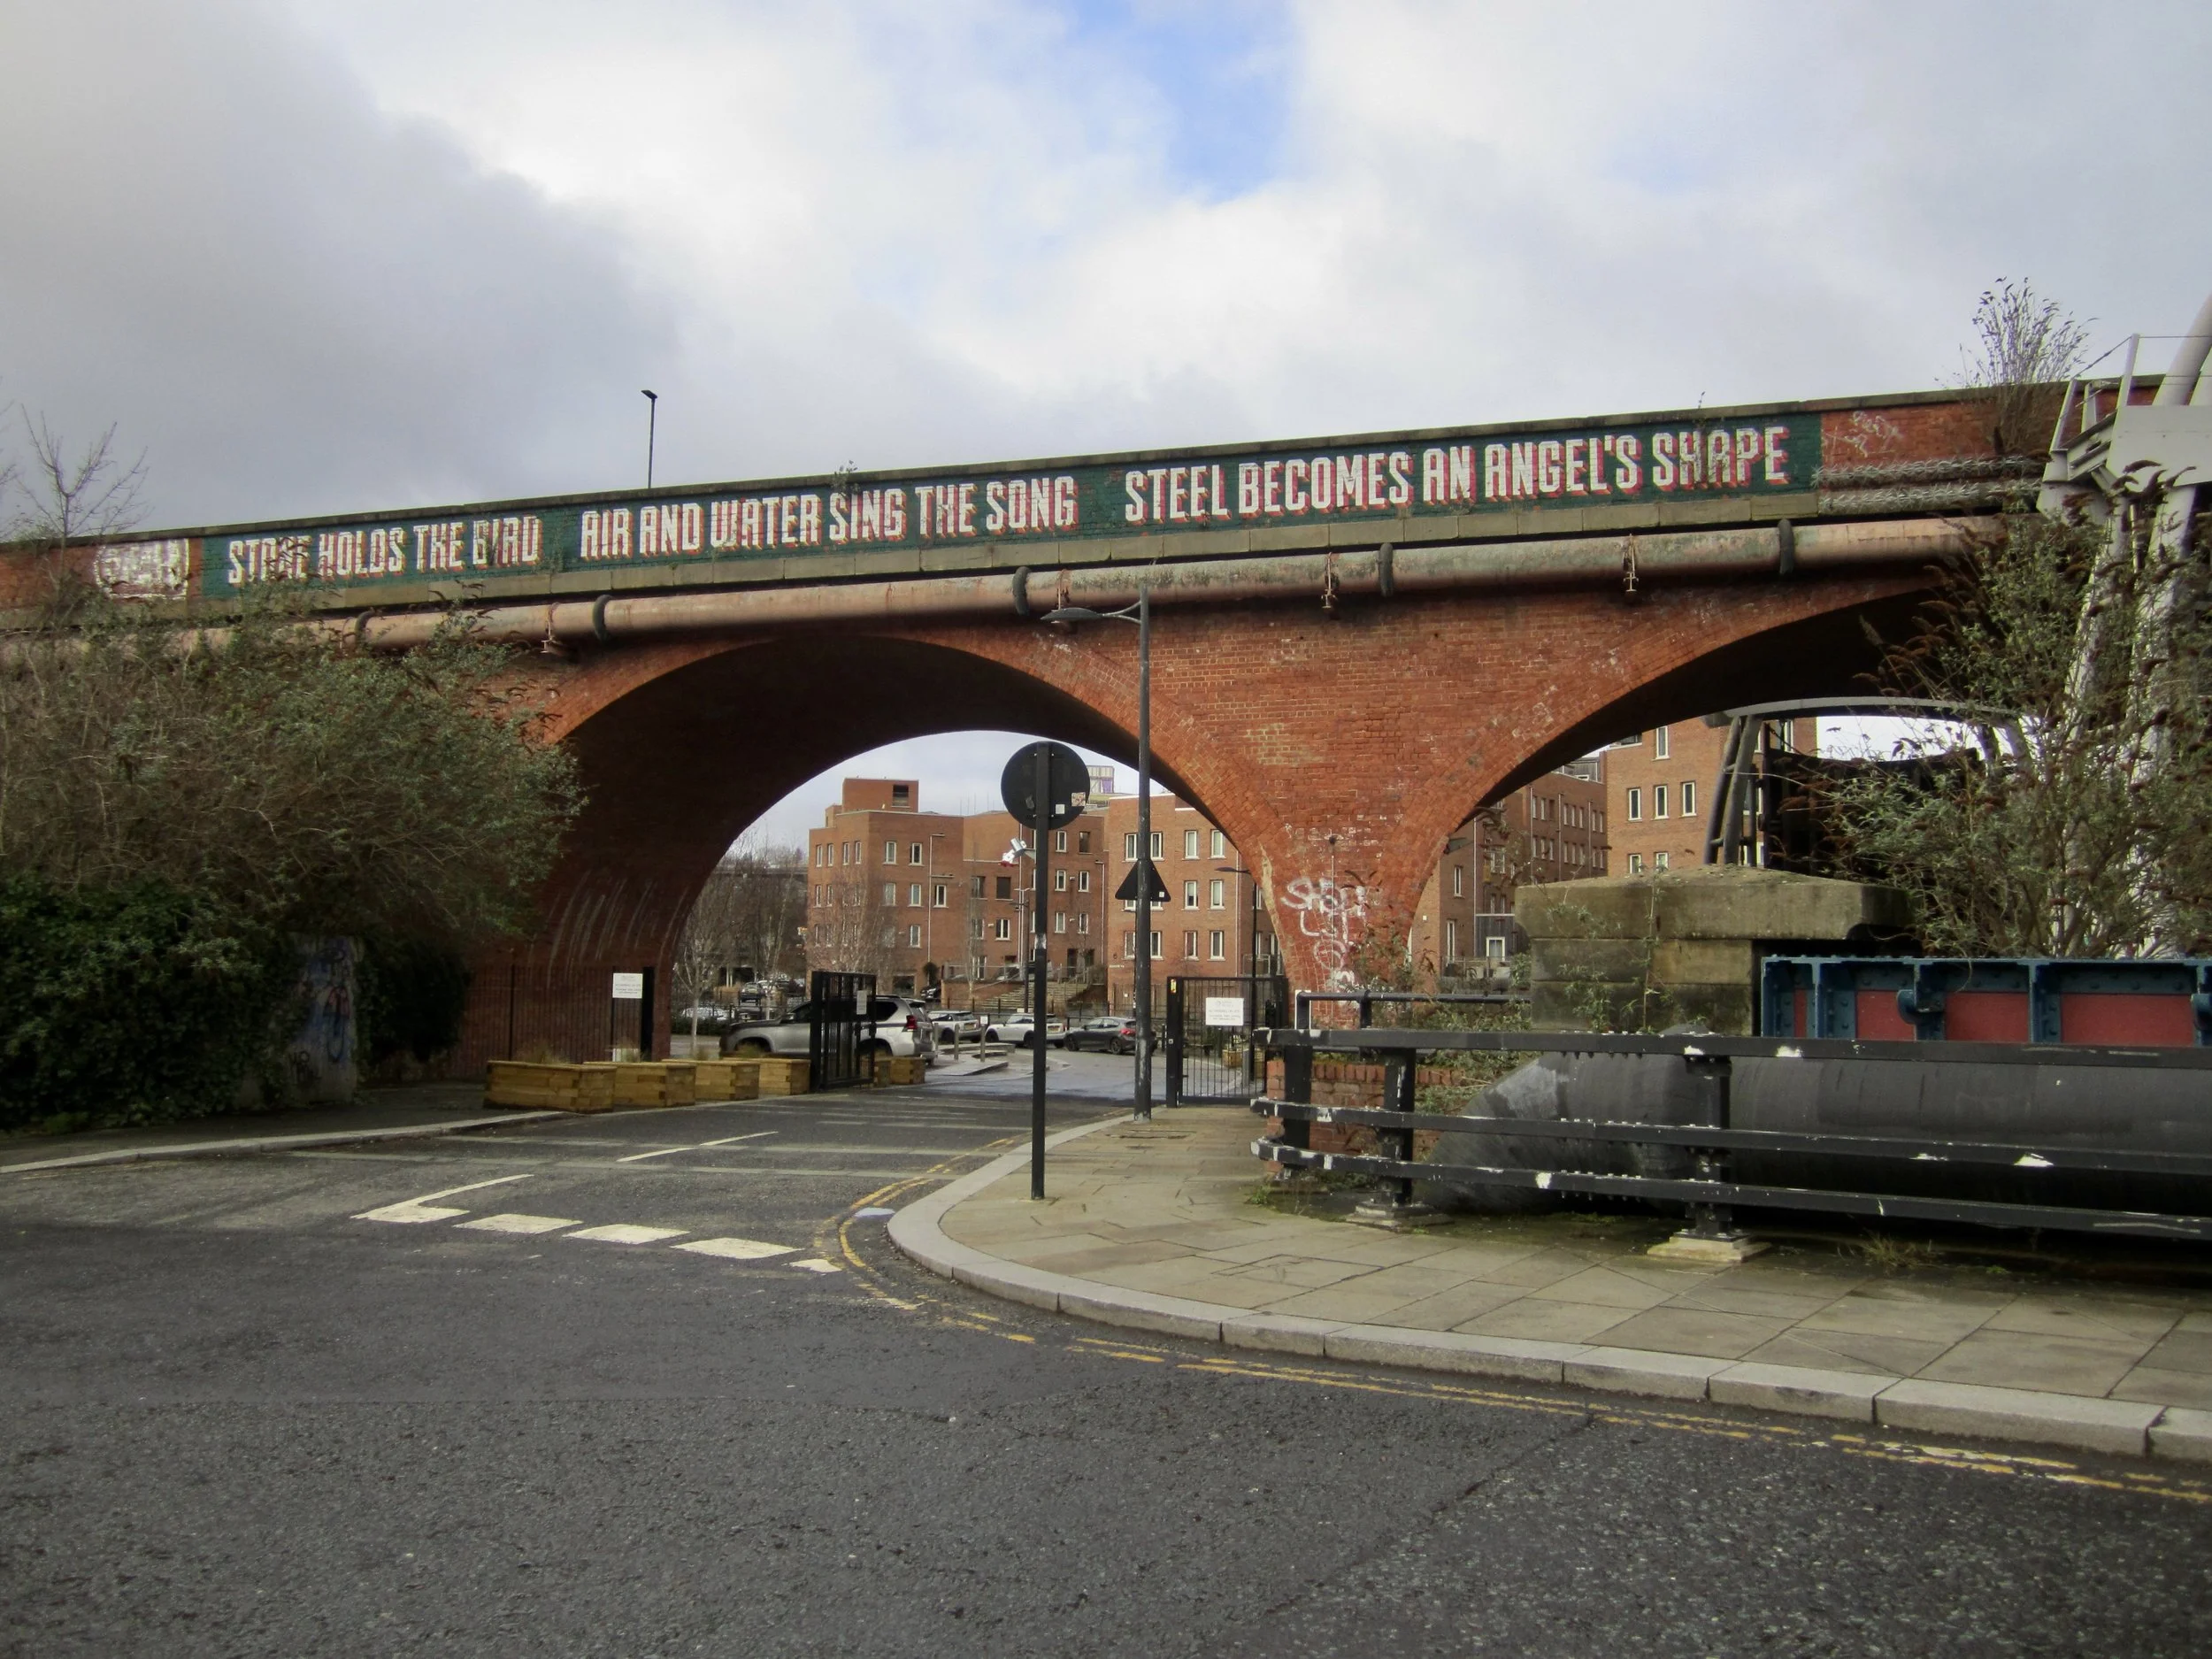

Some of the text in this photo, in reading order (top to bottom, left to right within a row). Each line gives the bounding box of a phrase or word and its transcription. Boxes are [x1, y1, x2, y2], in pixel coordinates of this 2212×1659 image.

[1125, 465, 1231, 524] STEEL
[1239, 452, 1414, 518] BECOMES
[1423, 446, 1474, 504] AN
[1485, 435, 1642, 497] ANGEL'S
[1653, 426, 1789, 489] SHAPE
[319, 528, 405, 576] HOLDS
[415, 522, 465, 570] THE
[472, 516, 542, 565] BIRD
[580, 476, 1079, 558] AIR AND WATER SING THE SONG
